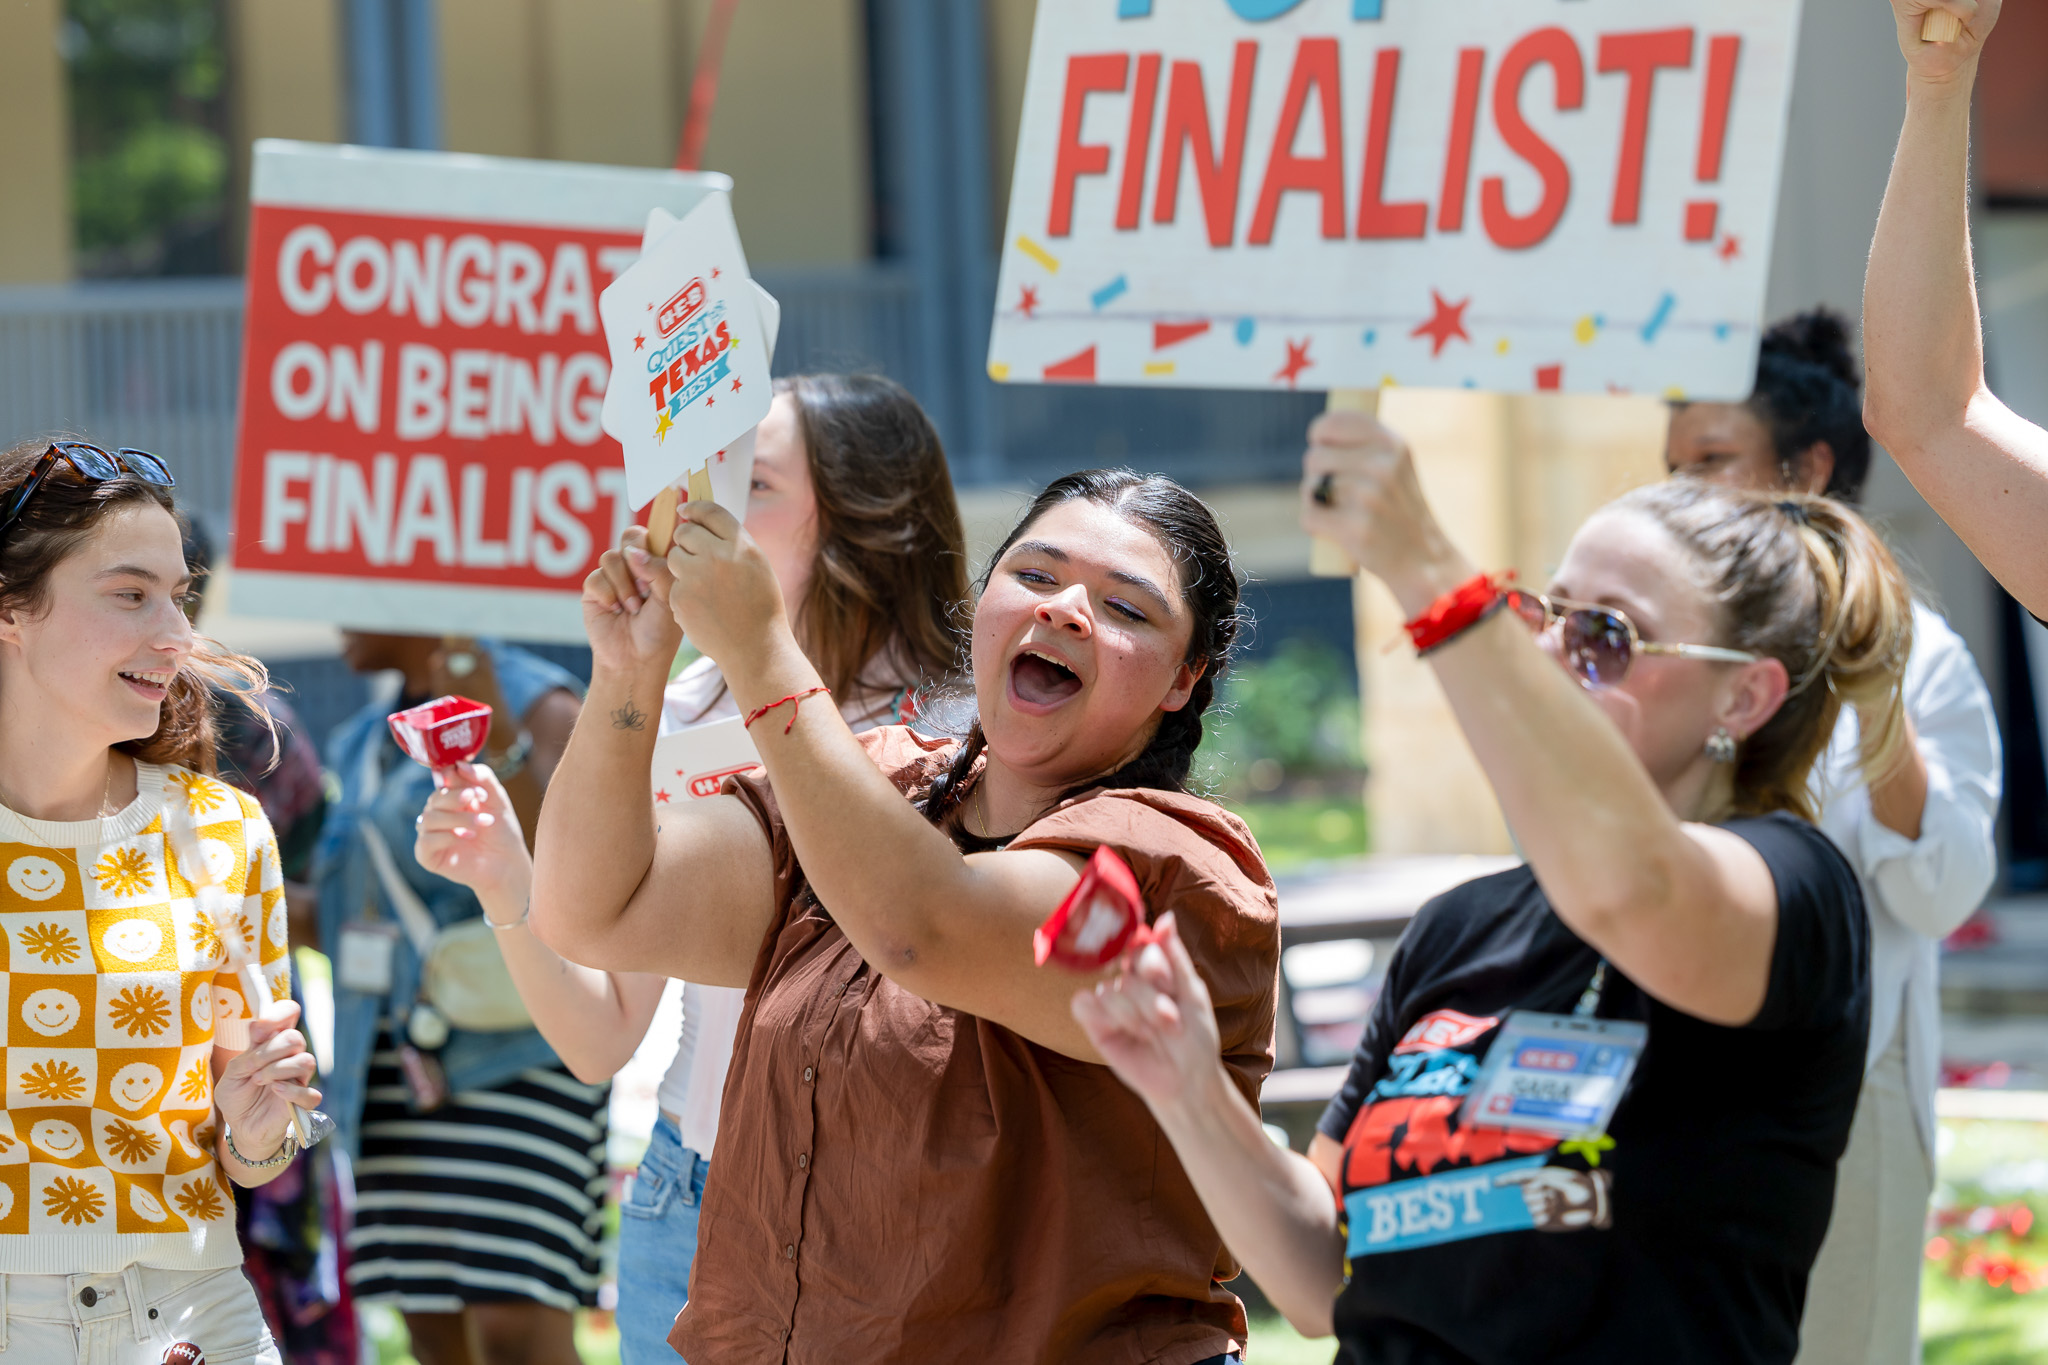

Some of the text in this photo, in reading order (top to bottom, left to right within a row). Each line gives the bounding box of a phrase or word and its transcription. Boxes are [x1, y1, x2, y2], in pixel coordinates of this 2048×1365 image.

[1047, 25, 1742, 250] FINALIST!
[646, 311, 712, 374] QUEST
[649, 319, 731, 412] TEXAS
[270, 338, 614, 446] ON BEING
[676, 363, 721, 410] BEST
[1365, 1174, 1490, 1245] BEST
